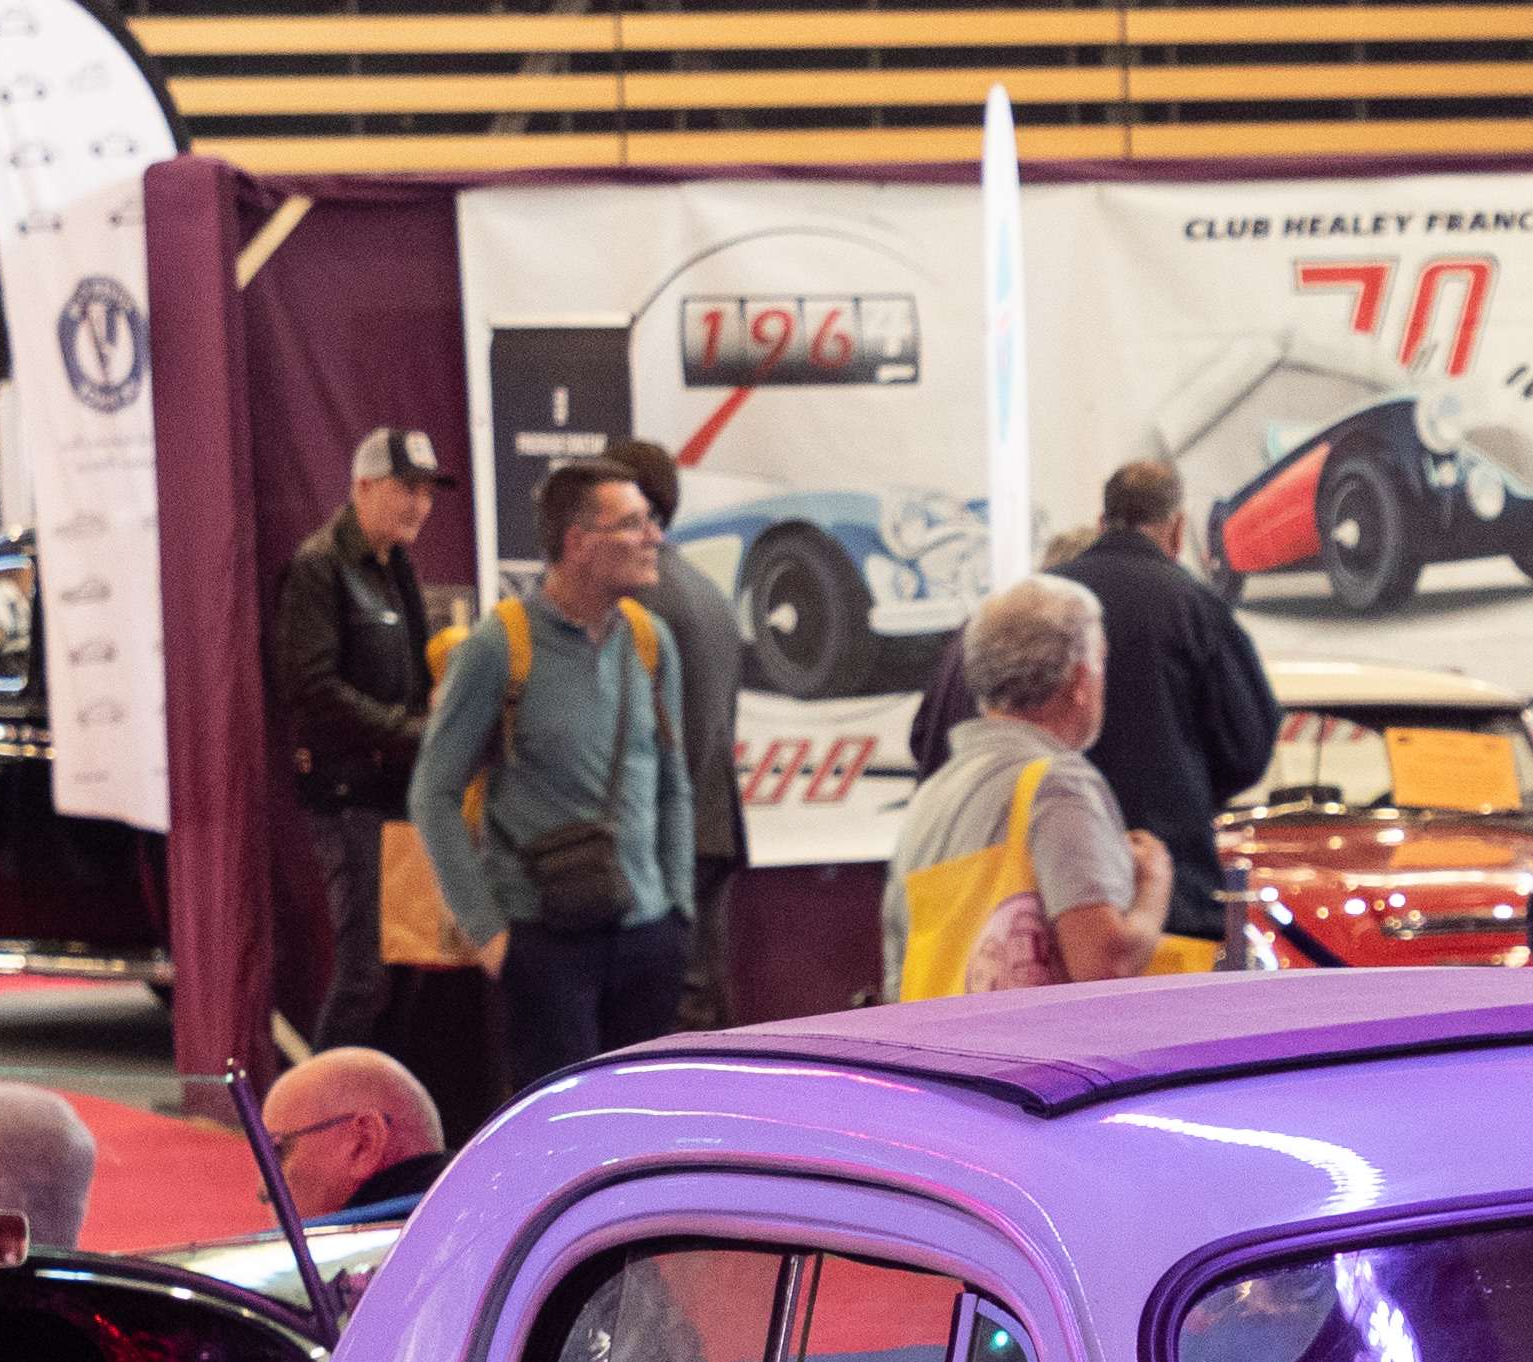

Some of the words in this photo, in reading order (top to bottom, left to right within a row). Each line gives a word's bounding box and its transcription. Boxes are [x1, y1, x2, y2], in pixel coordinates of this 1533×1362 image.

[1184, 215, 1272, 241] CLUB
[1283, 211, 1413, 238] HEALEY
[1293, 252, 1499, 378] 70
